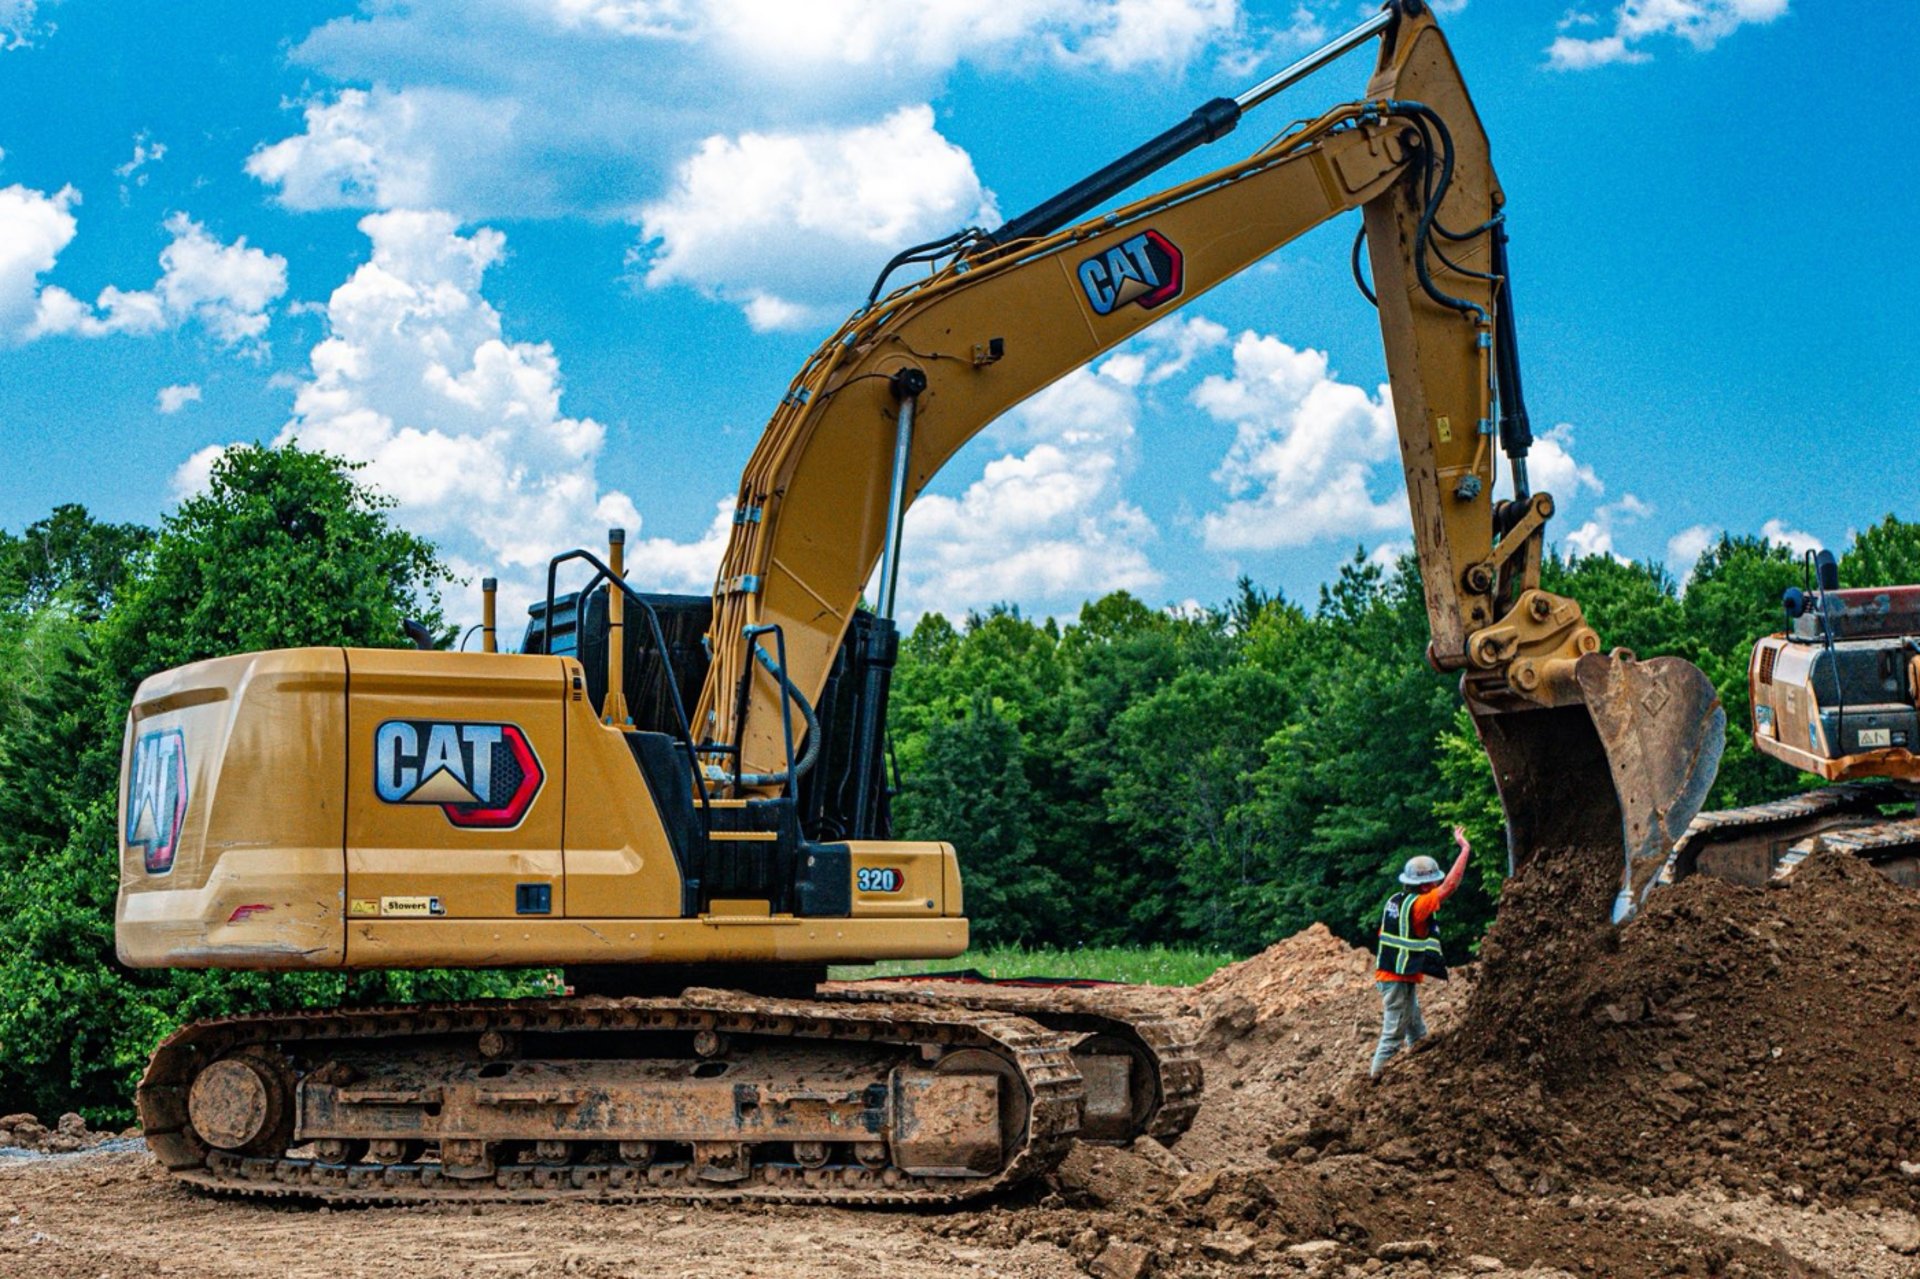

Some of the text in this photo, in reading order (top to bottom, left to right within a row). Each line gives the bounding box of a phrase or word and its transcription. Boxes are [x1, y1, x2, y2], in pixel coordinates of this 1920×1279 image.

[1079, 233, 1160, 314] CAT
[130, 734, 176, 842] CAT
[377, 721, 502, 802] CAT
[388, 901, 427, 910] Stowers
[858, 869, 894, 890] 320
